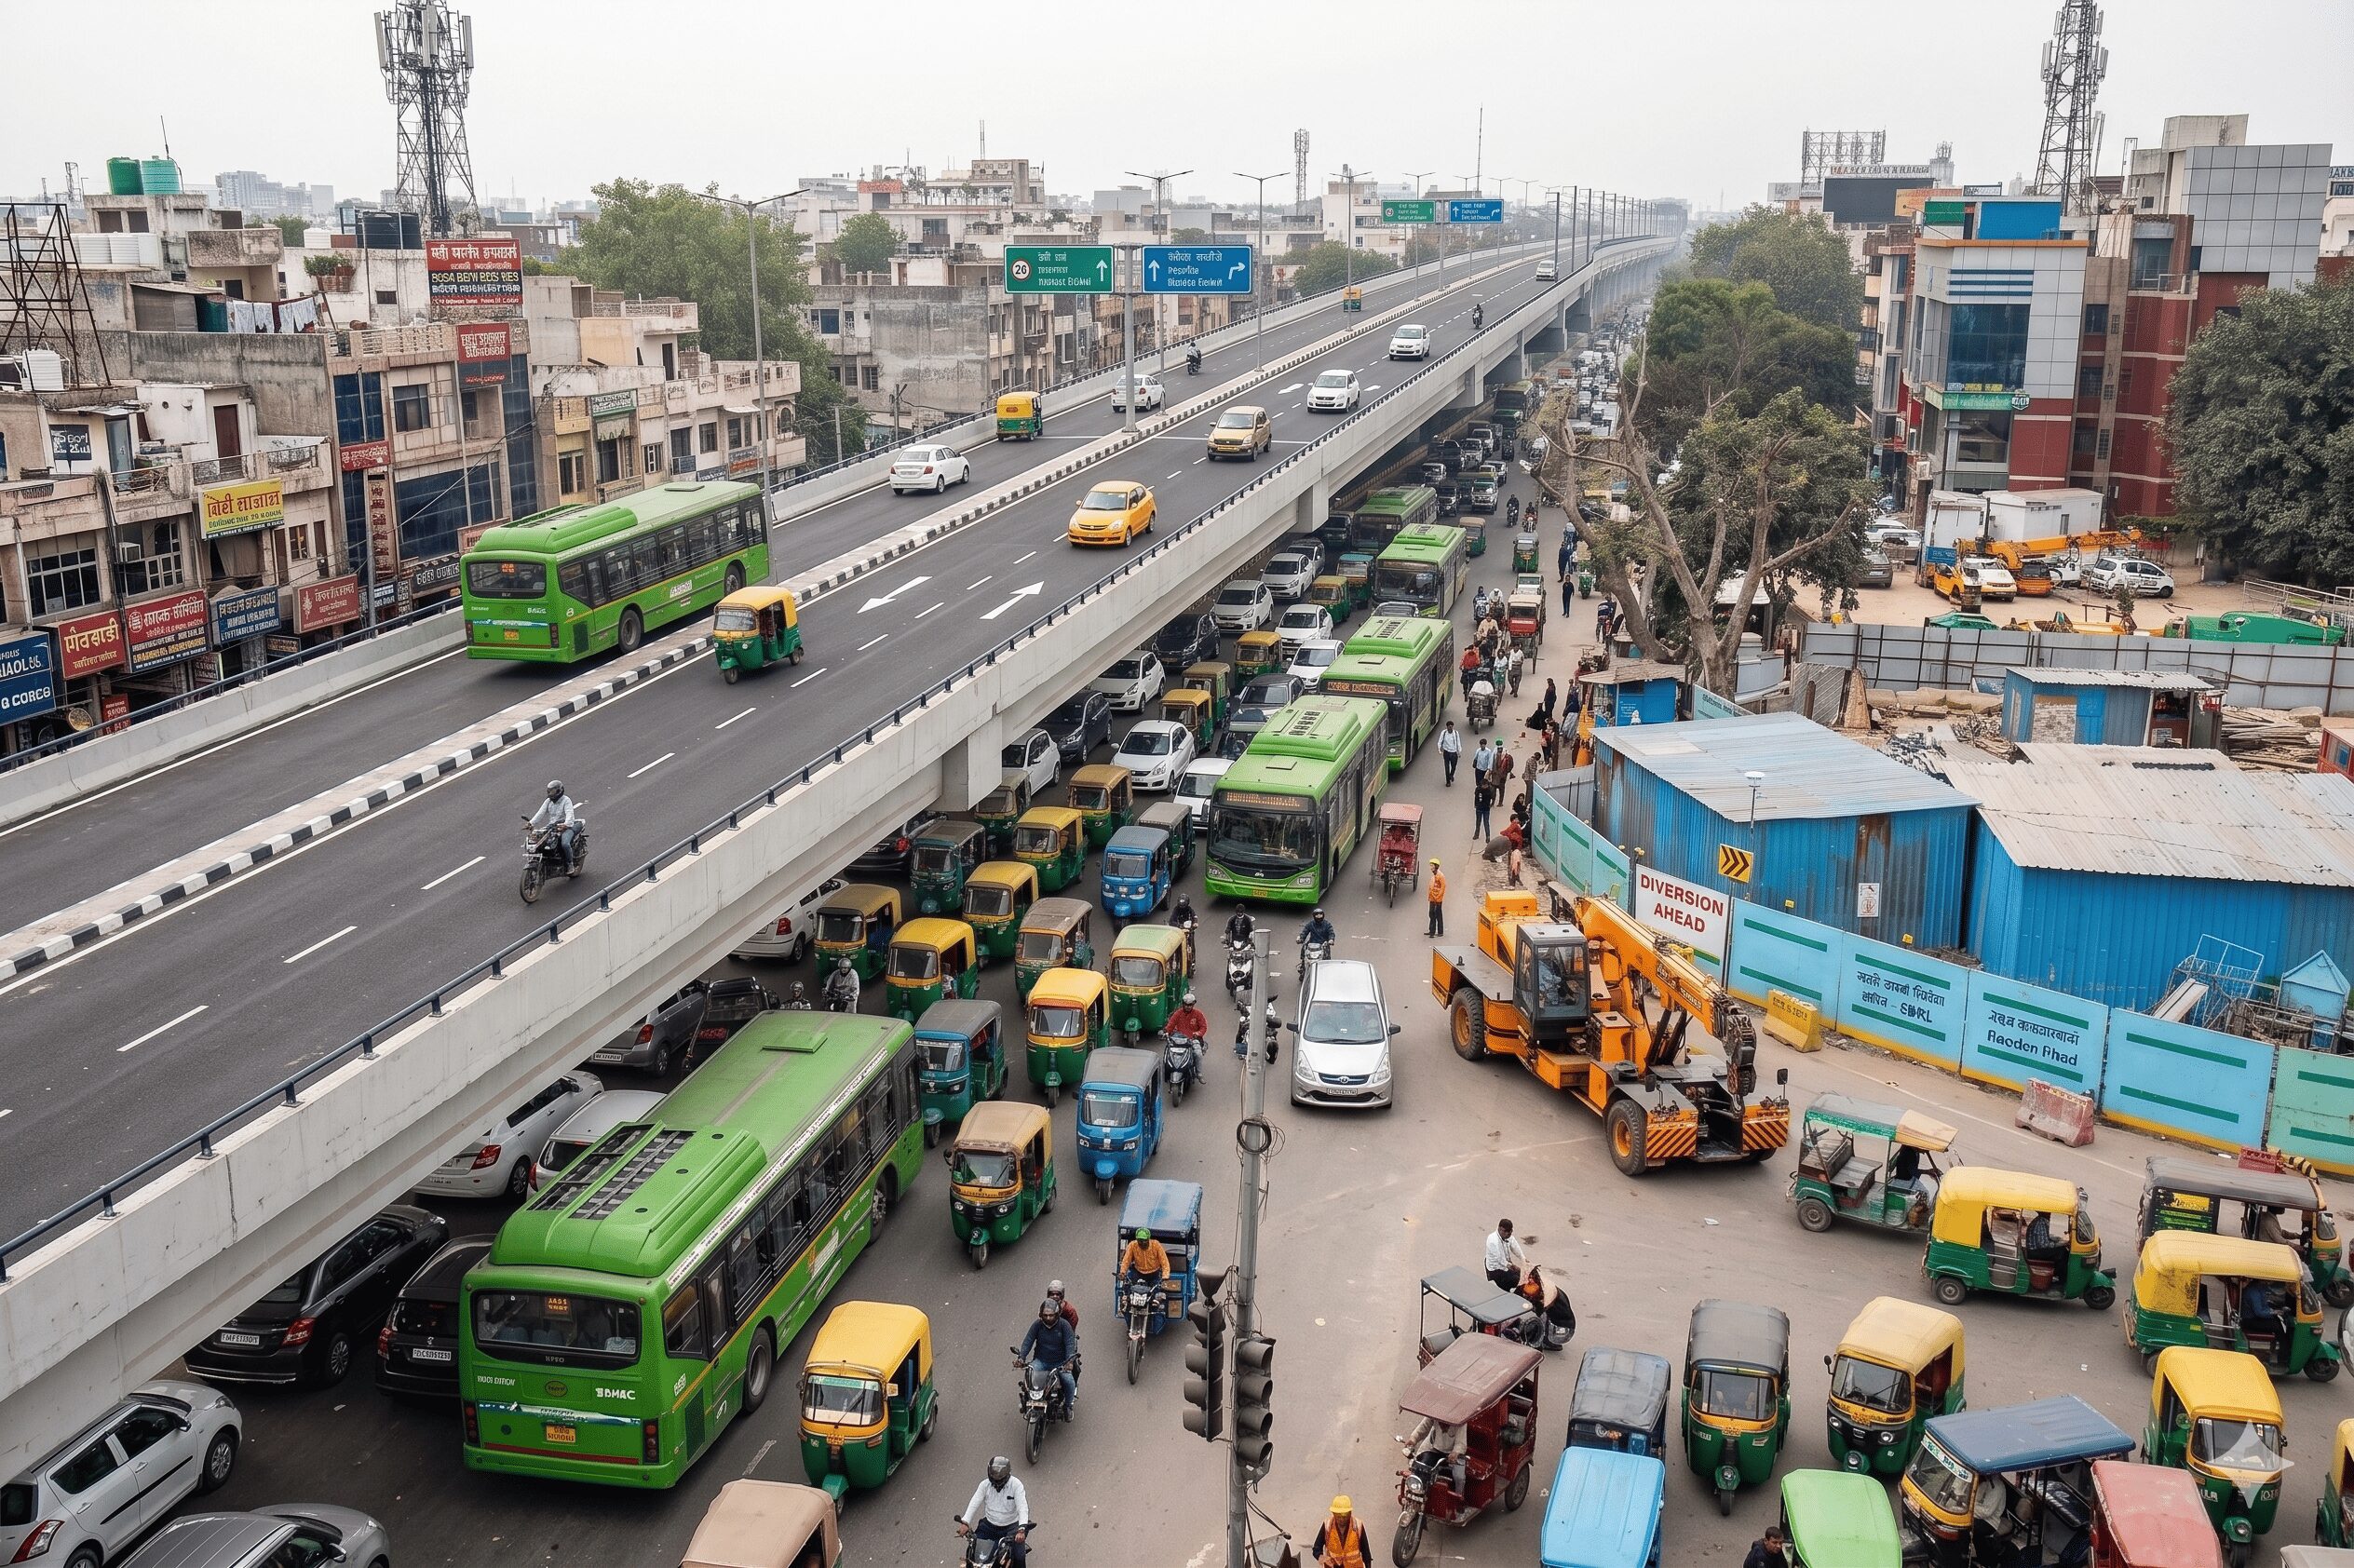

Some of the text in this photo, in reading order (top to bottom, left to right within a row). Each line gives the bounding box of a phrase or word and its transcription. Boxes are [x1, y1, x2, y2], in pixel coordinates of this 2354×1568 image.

[1015, 264, 1027, 275] 26
[1641, 873, 1724, 917] DIVERSION
[1654, 902, 1706, 933] AHEAD
